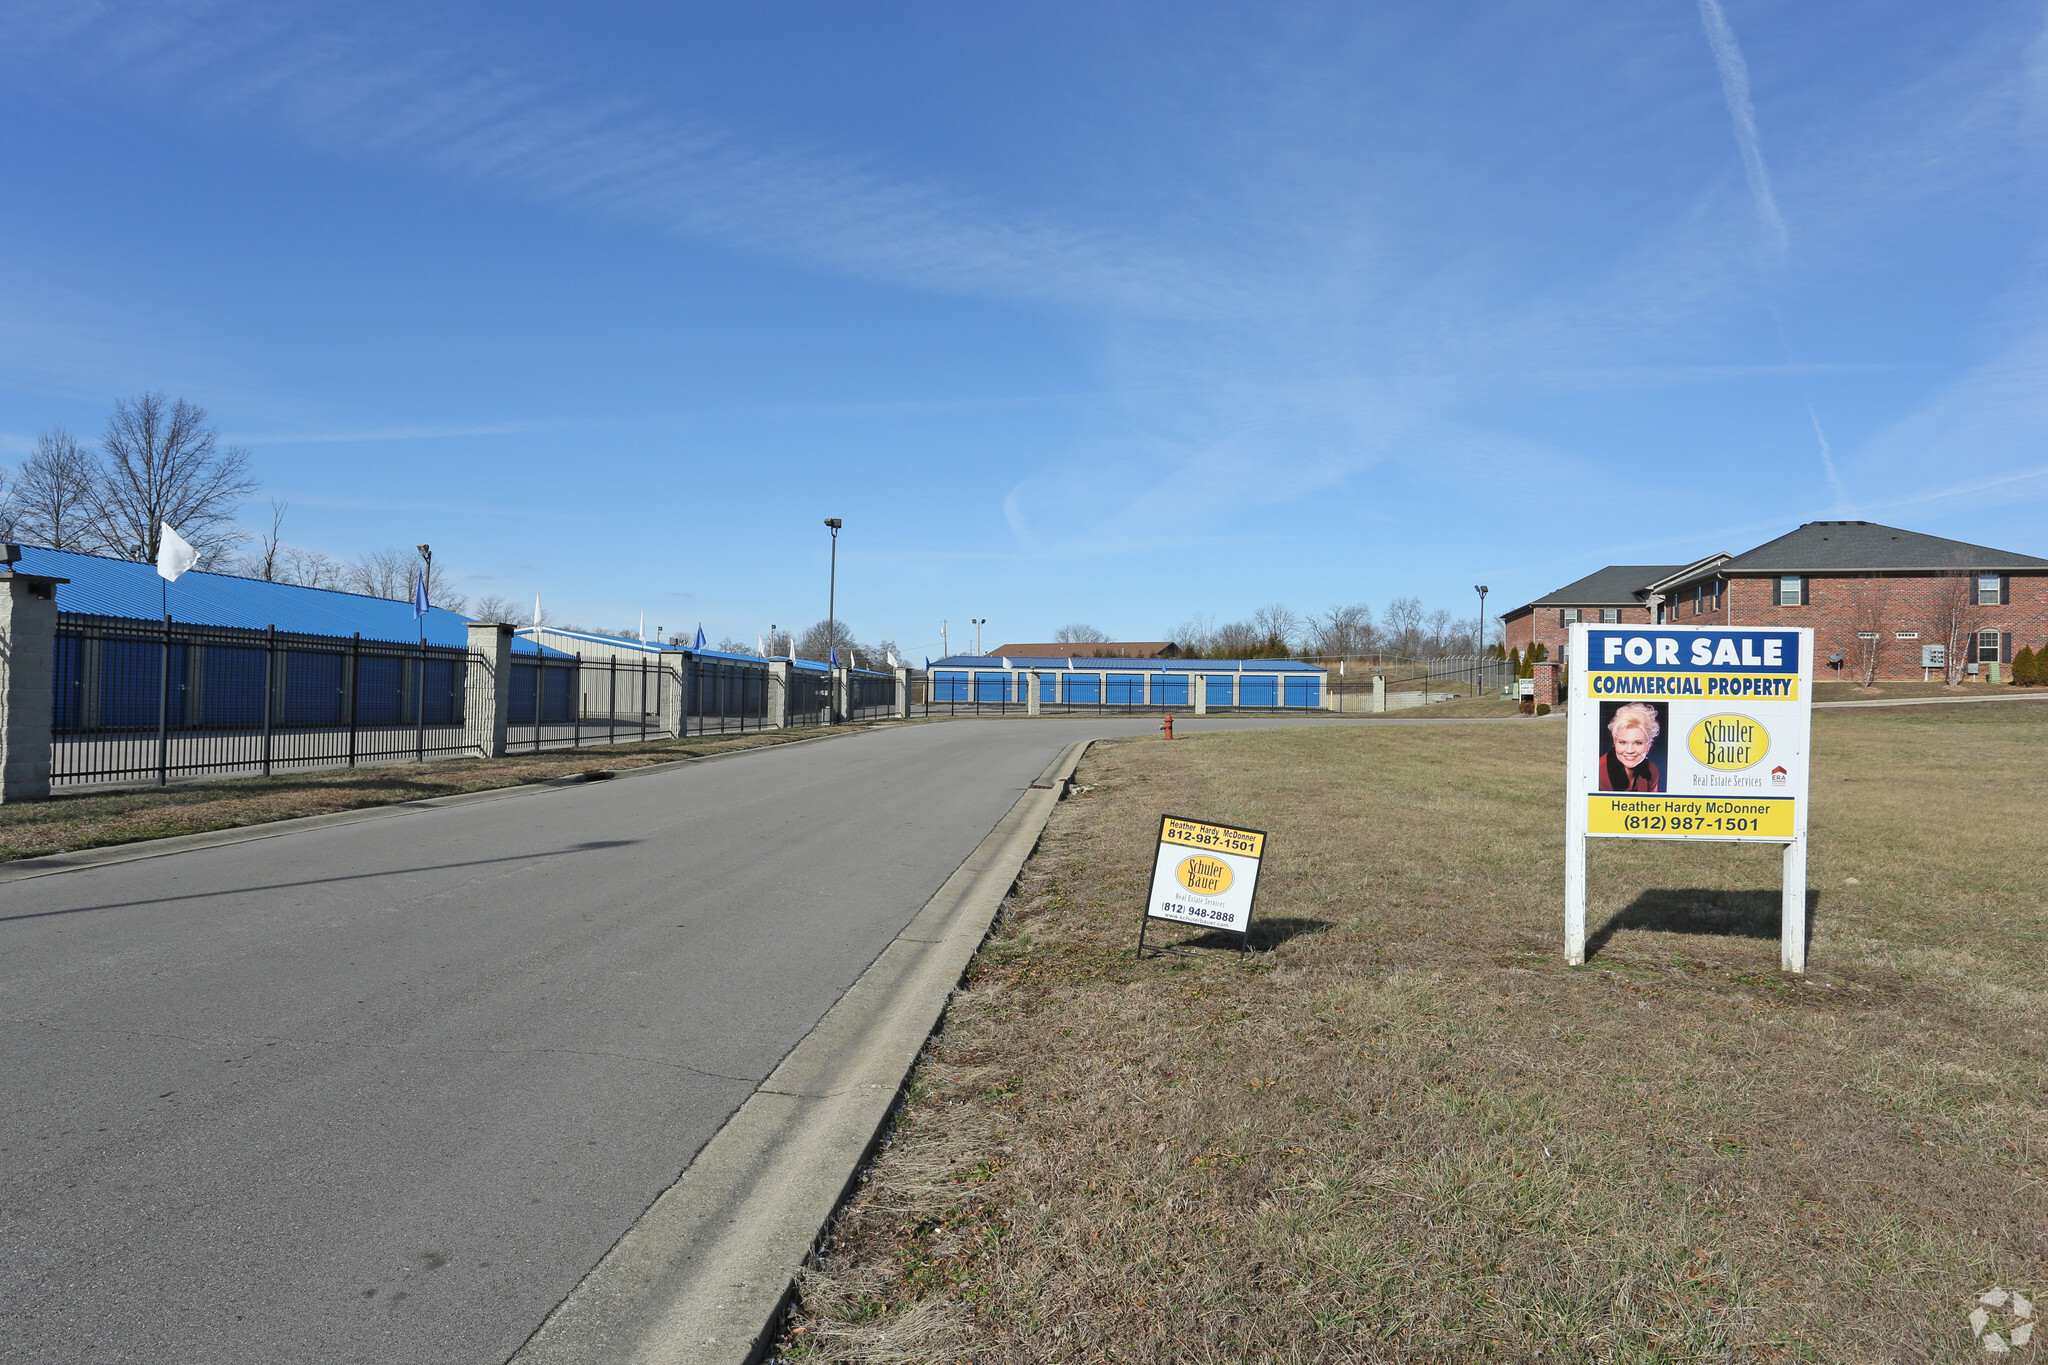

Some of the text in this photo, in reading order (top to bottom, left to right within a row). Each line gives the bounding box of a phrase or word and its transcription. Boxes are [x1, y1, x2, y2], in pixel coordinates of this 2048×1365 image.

[1604, 637, 1783, 667] FOR SALE
[1593, 676, 1792, 696] COMMERCIAL PROPERTY
[1704, 719, 1754, 743] Schuler
[1707, 741, 1751, 764] Bauer
[1693, 774, 1762, 788] Real Estate Services
[1611, 800, 1770, 816] Heather Hardy McDonner
[1169, 820, 1256, 842] Heather Hardy McDonner
[1624, 815, 1758, 832] (812) 987-1501
[1167, 829, 1255, 852] 812-987-1501
[1188, 859, 1224, 878] Schuler
[1187, 872, 1220, 891] Bauer
[1161, 902, 1235, 923] (812) 948-2888
